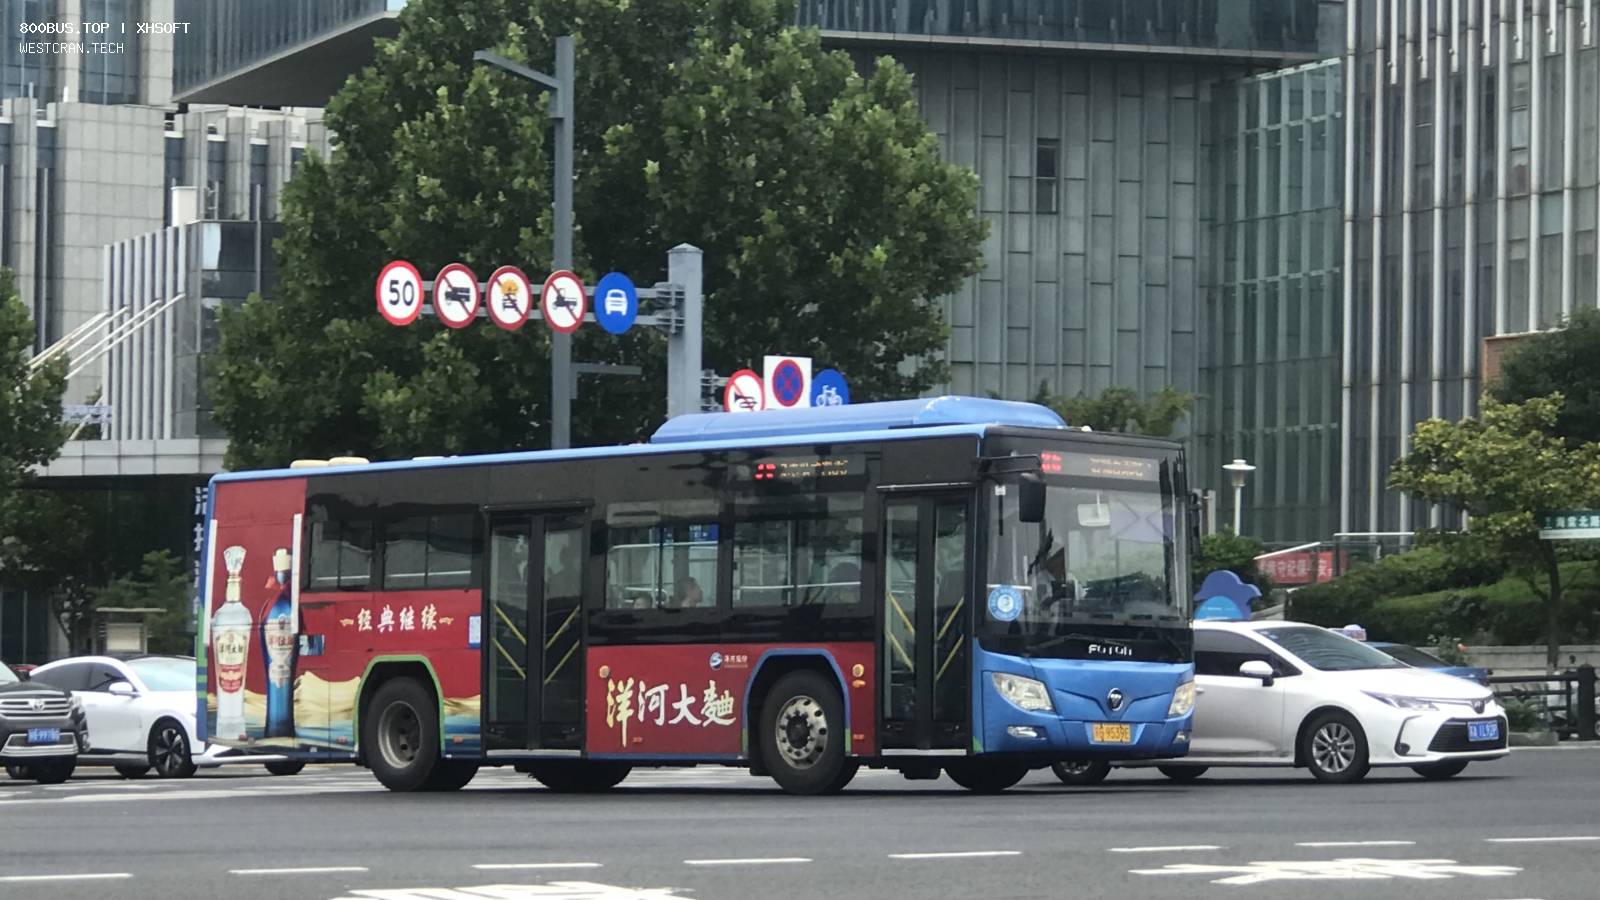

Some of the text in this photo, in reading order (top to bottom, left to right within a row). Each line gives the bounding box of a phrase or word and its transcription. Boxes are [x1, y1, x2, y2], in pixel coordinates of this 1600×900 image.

[389, 279, 414, 306] 50
[357, 603, 437, 633] 经典继续
